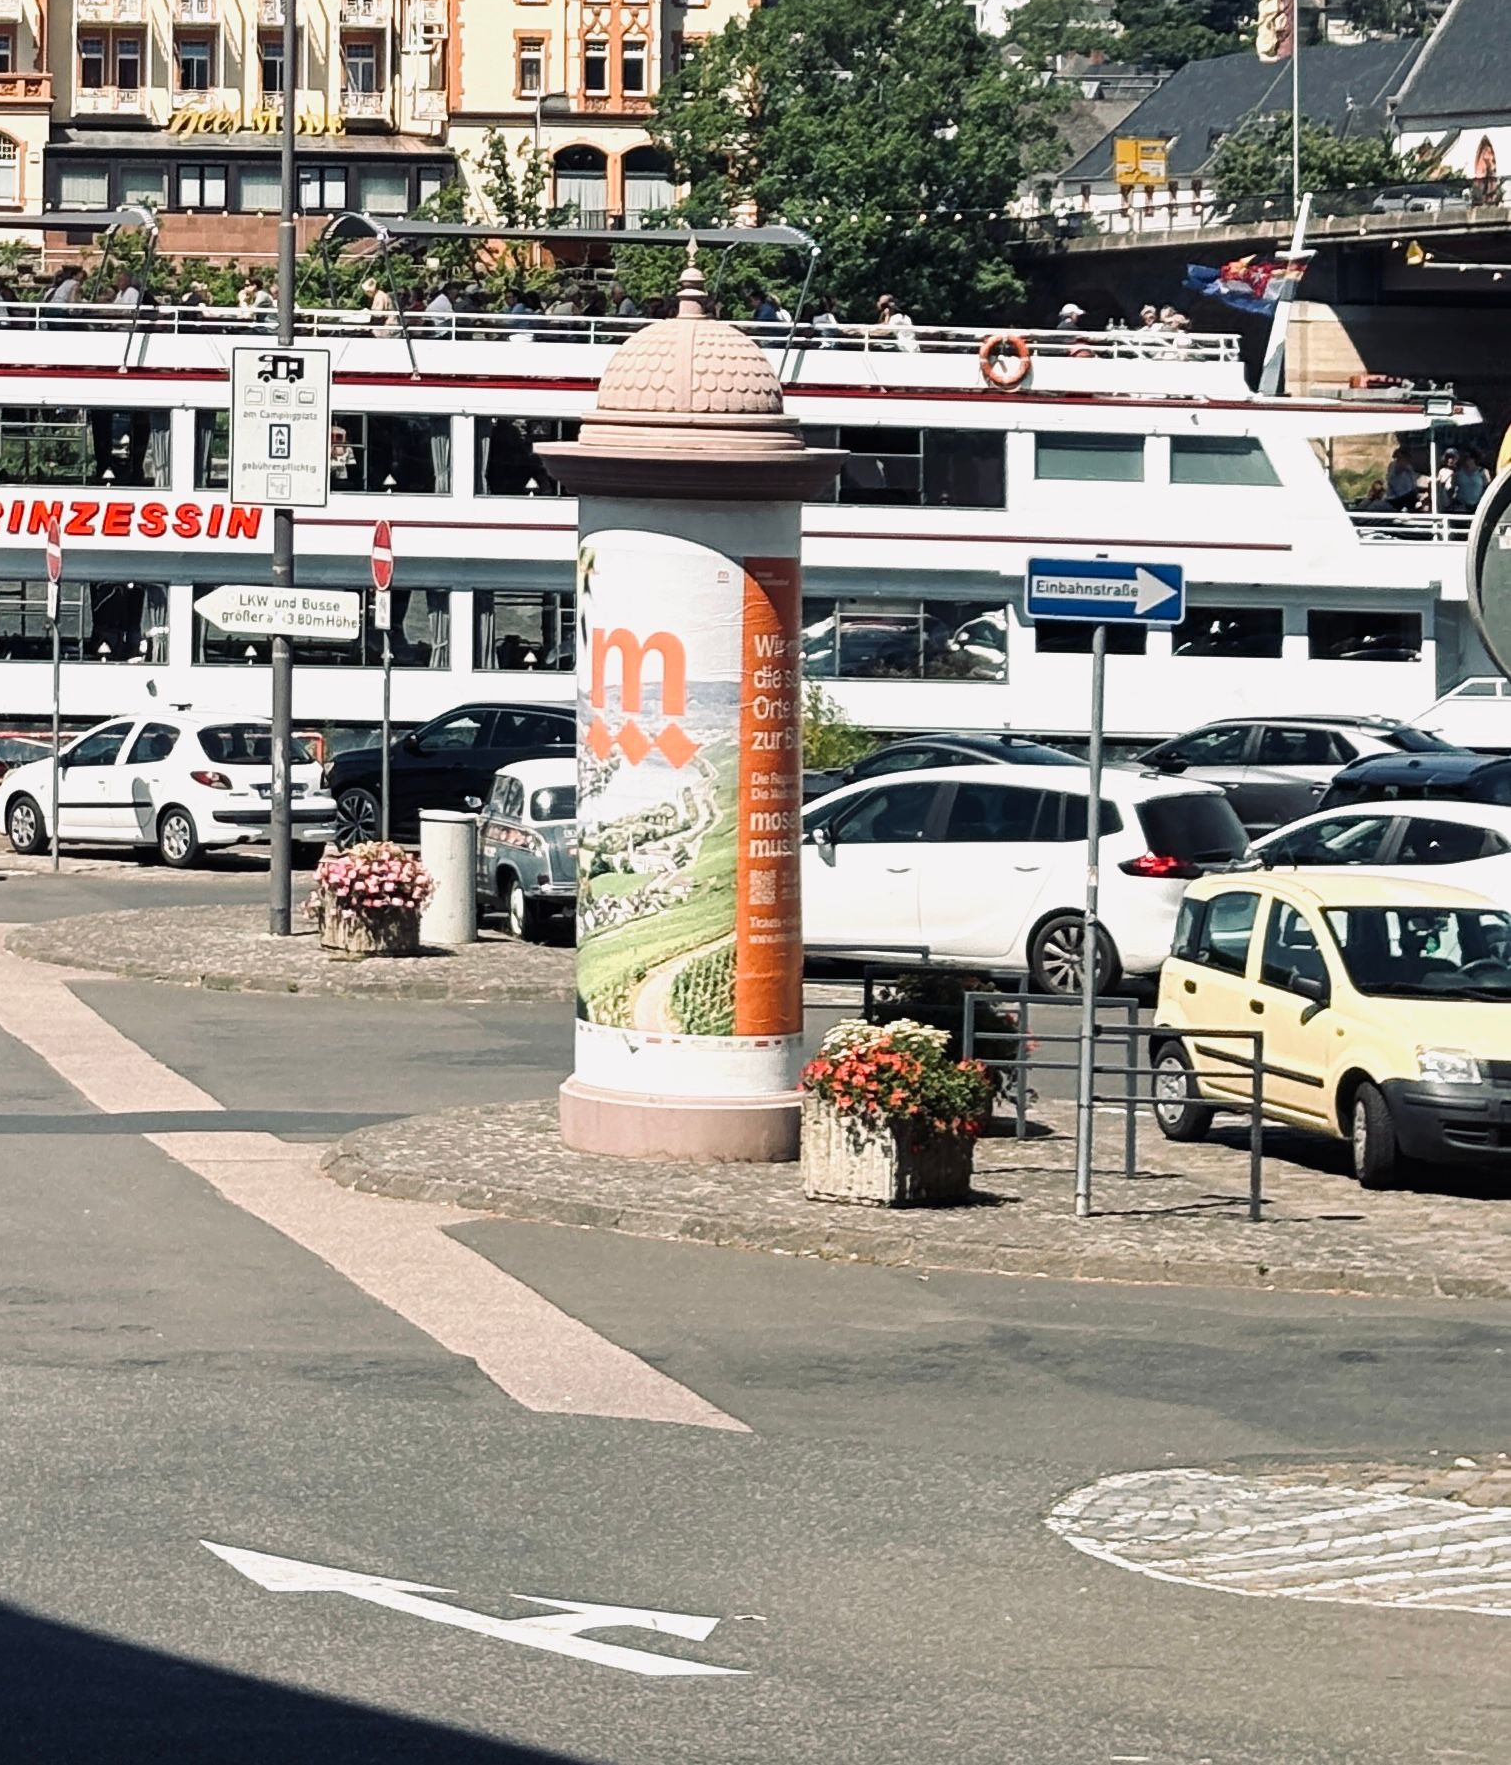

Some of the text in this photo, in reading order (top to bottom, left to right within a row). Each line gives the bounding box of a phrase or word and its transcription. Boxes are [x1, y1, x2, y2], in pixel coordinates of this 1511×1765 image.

[260, 410, 317, 421] Campingplatz
[242, 462, 316, 473] gebührenpflichtig
[1036, 580, 1138, 596] Einbahnstraße
[240, 594, 340, 612] LKW und Busse
[222, 611, 264, 623] größer
[751, 731, 783, 751] zur
